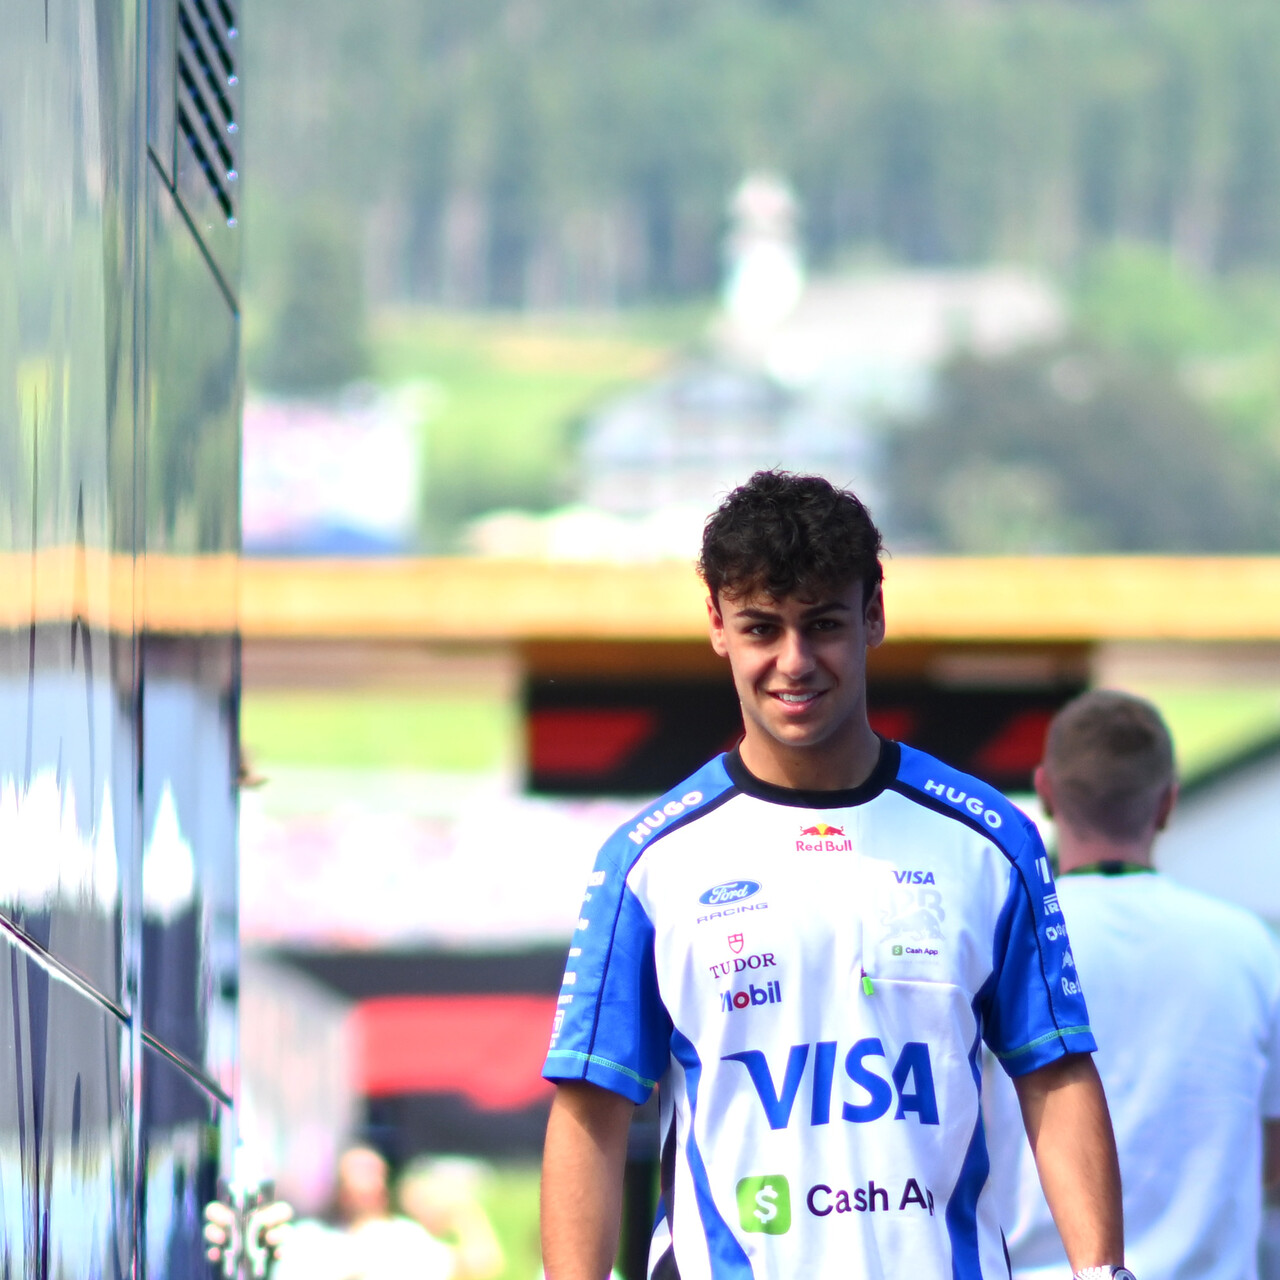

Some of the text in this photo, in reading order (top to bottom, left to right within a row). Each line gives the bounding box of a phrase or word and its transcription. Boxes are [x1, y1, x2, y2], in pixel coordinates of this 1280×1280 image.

[628, 790, 703, 845] HUGO
[924, 779, 1002, 829] HUGO
[796, 839, 853, 852] Red Bull
[890, 870, 936, 885] VISA
[696, 901, 769, 925] RACING
[905, 946, 939, 956] Cash App
[708, 952, 777, 979] TUDOR
[720, 1036, 940, 1131] VISA
[806, 1180, 890, 1217] Cash
[898, 1177, 935, 1217] Ap
